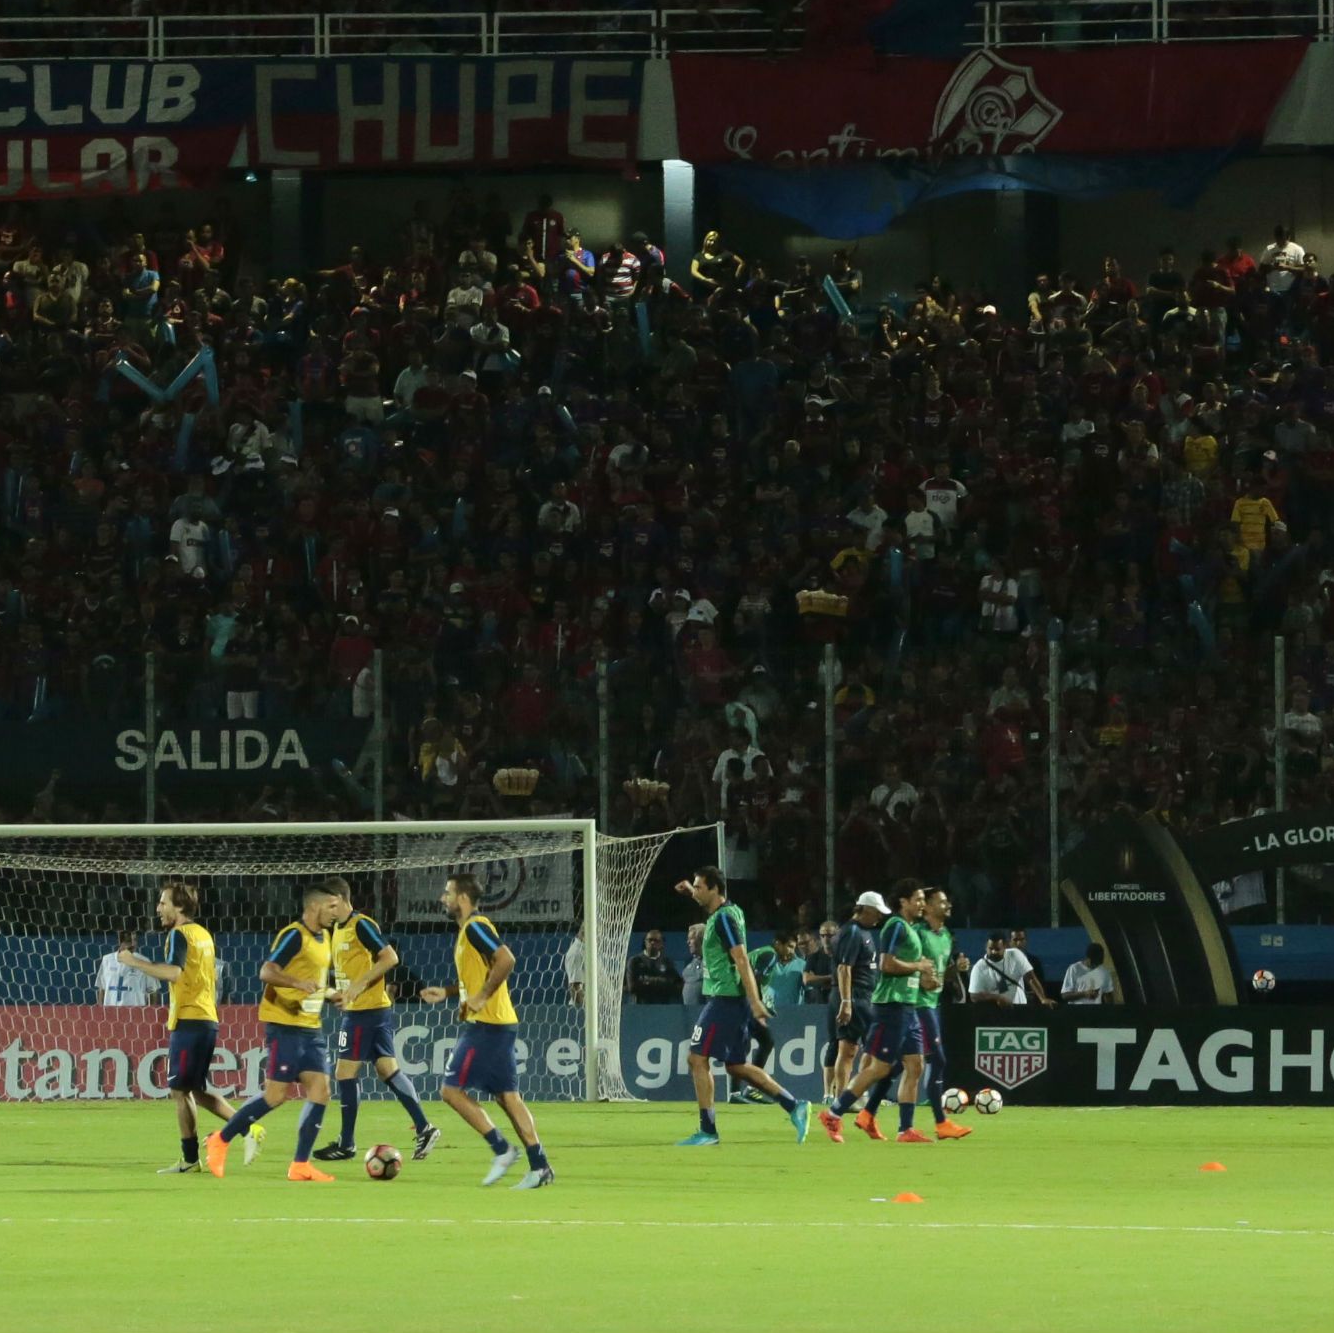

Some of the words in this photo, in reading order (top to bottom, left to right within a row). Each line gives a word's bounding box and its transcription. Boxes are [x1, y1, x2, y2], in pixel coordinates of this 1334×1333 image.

[255, 59, 634, 164] CHUPE
[114, 728, 310, 771] SALIDA
[1254, 832, 1279, 853] LA
[1088, 891, 1167, 902] LIBERTADORES
[981, 1032, 1041, 1051] TAG
[979, 1055, 1043, 1084] HEUER
